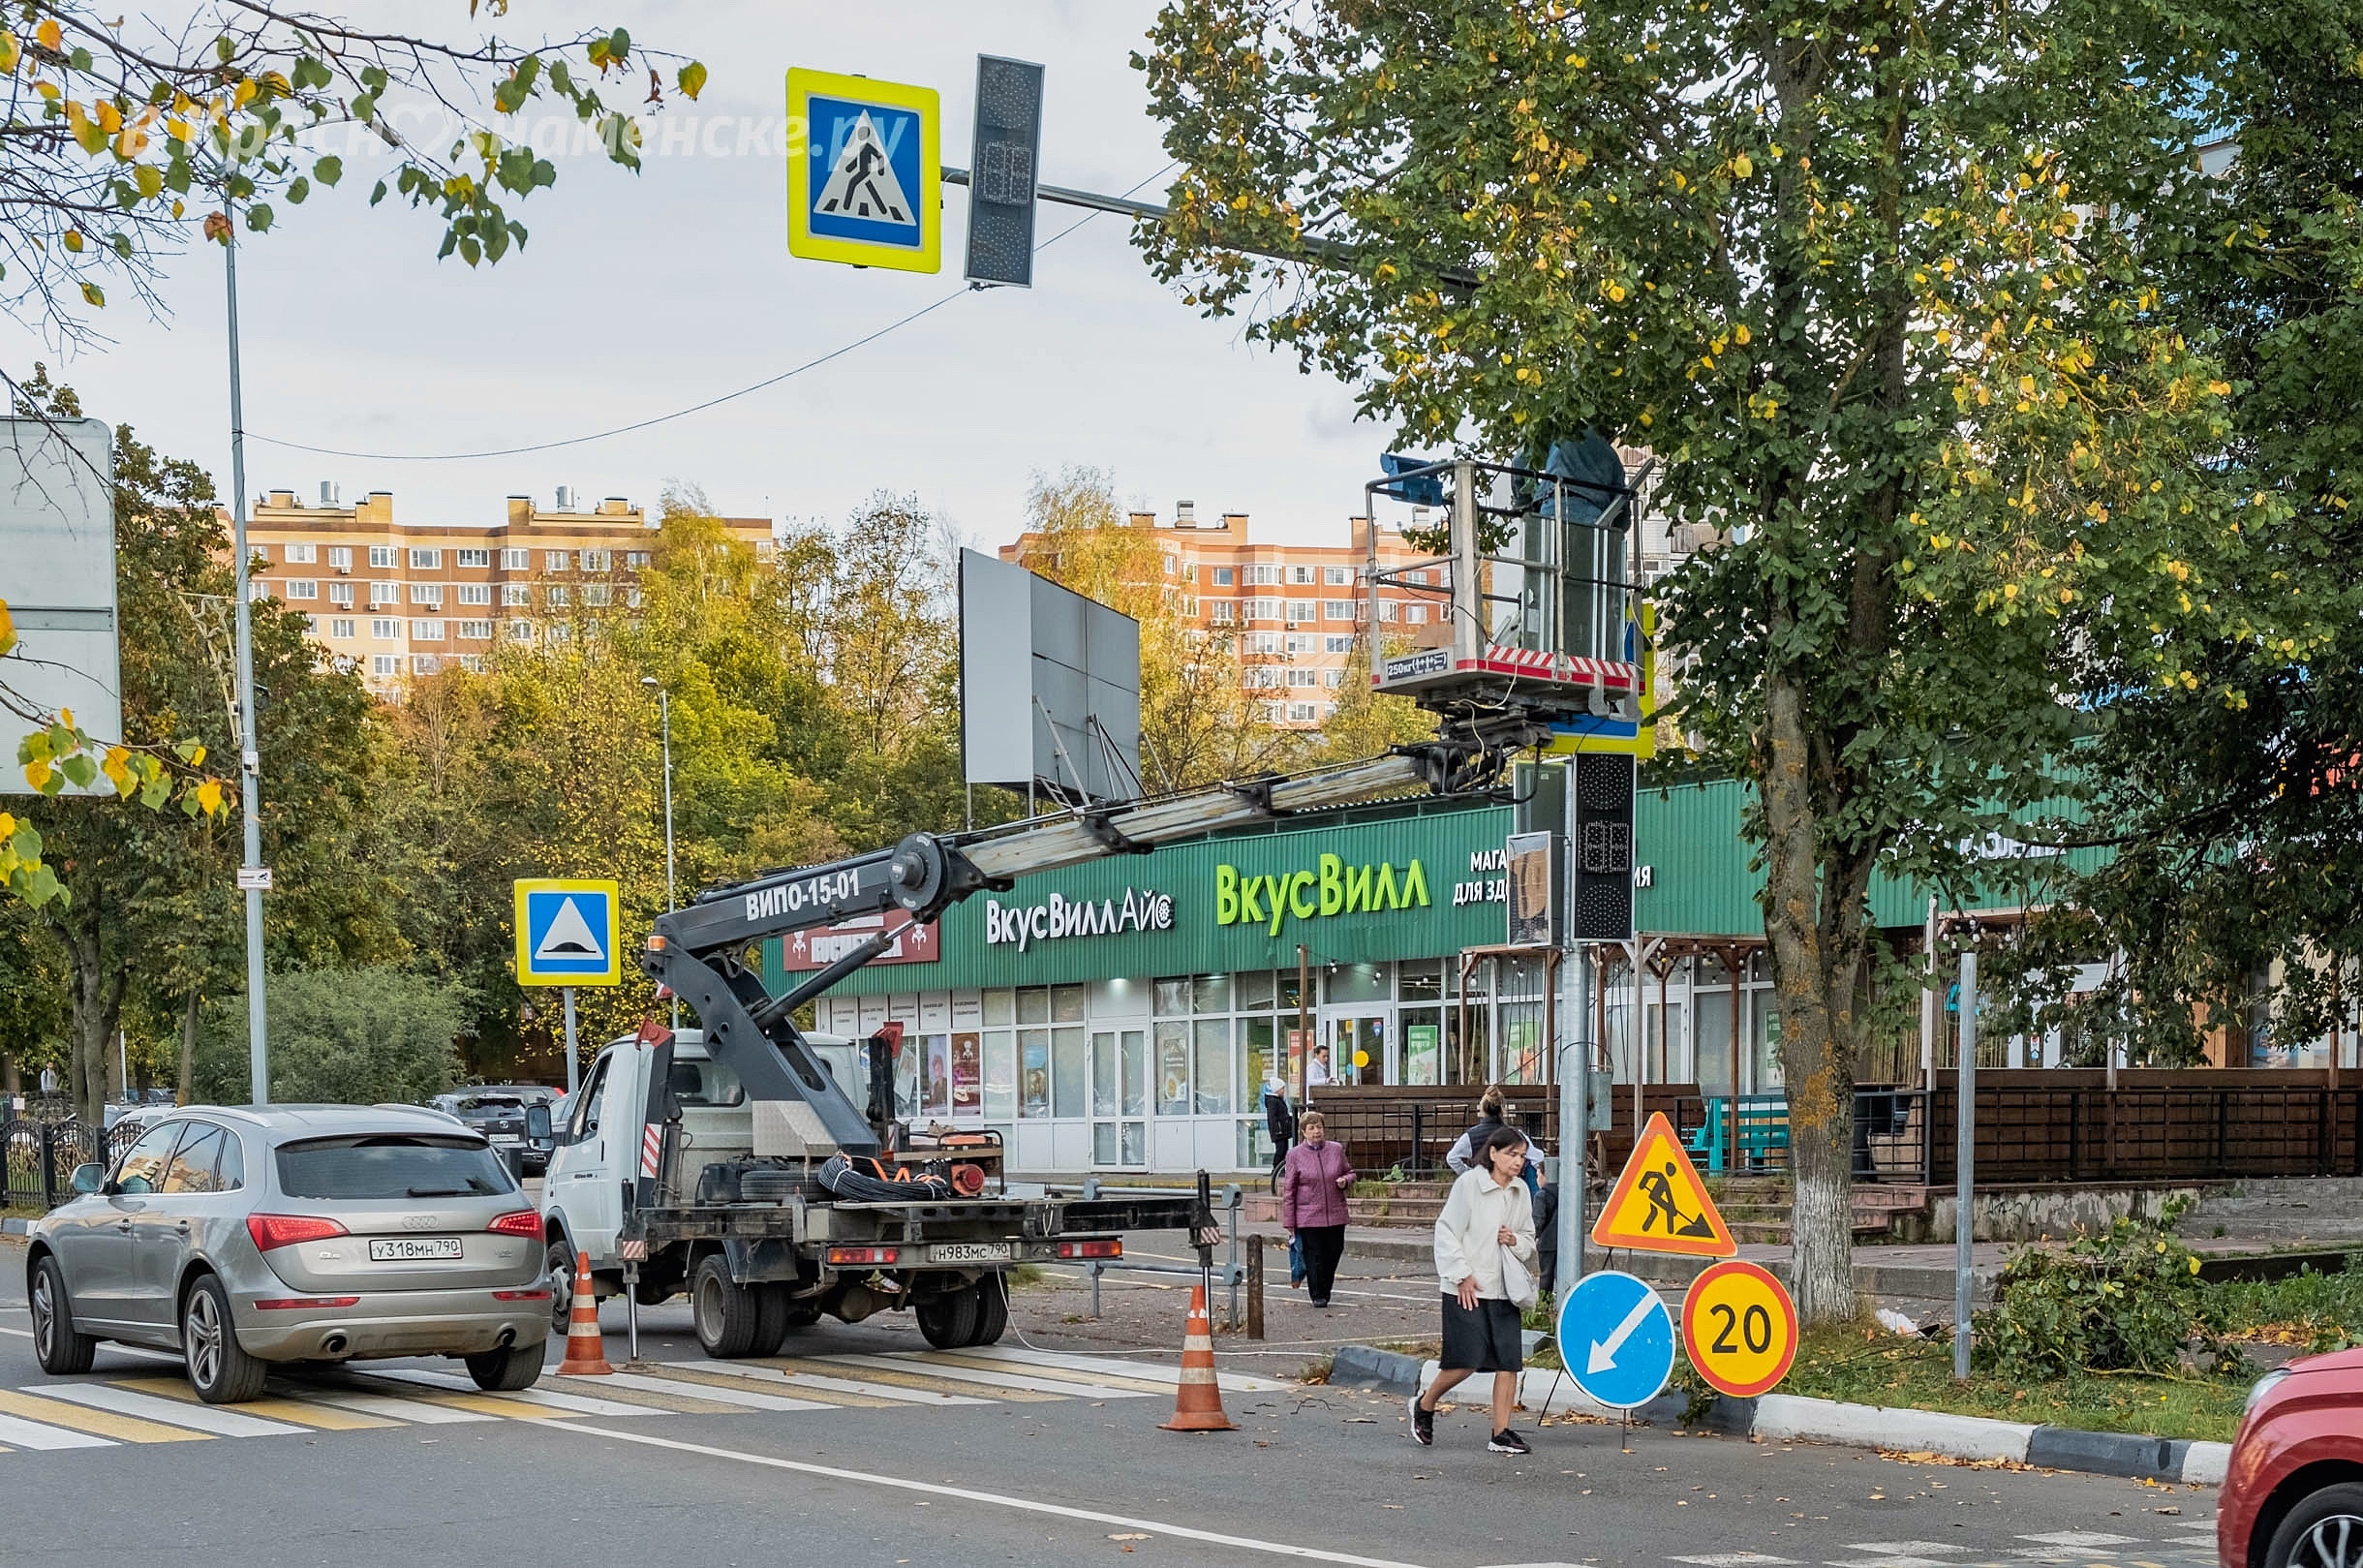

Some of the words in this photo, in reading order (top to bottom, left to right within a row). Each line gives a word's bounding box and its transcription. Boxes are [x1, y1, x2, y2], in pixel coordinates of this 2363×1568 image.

[1470, 848, 1508, 873] МАГА
[746, 869, 860, 921] ВИПО-15-01
[1216, 853, 1431, 937] ВкусВилл
[1453, 882, 1484, 906] ДЛЯ
[436, 1240, 459, 1253] 790
[1709, 1304, 1772, 1354] 20
